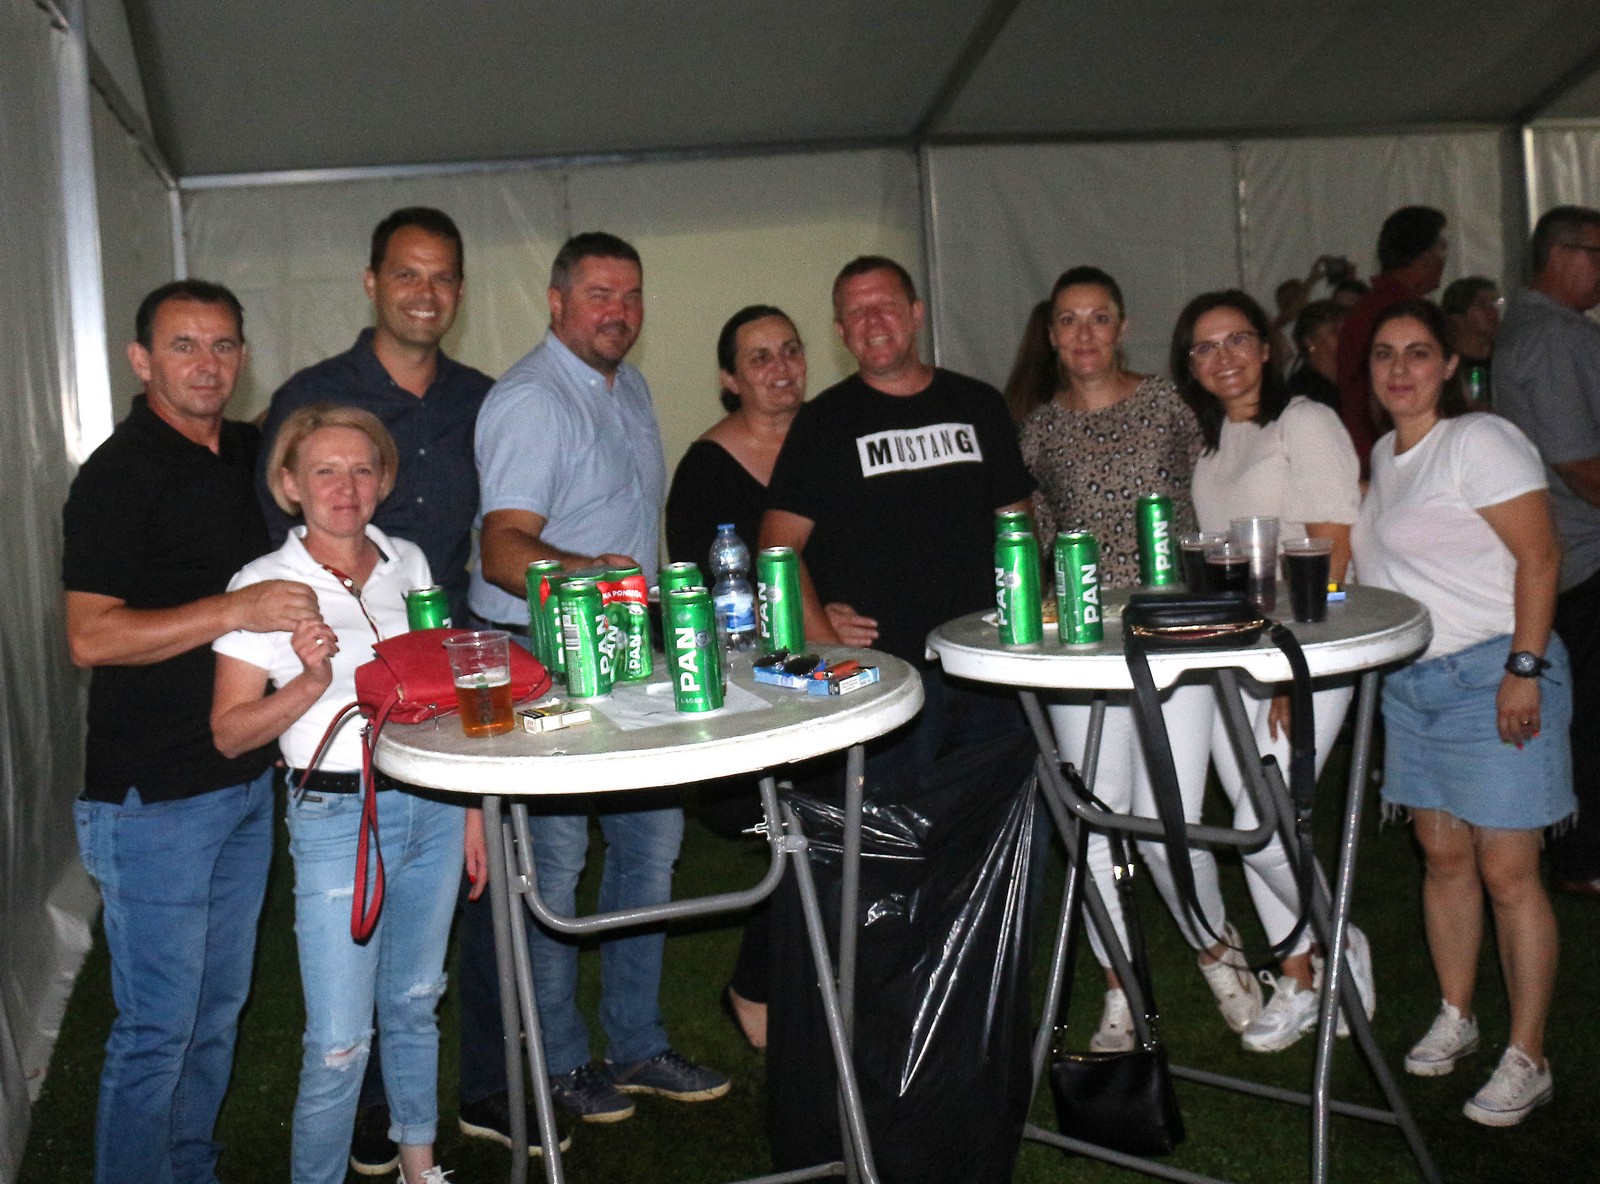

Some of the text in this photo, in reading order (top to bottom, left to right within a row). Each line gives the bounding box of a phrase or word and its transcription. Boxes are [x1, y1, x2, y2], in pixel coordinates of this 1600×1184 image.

[866, 430, 974, 467] MUSTANG
[1152, 521, 1171, 571] PAN
[758, 582, 770, 638] PAN
[995, 568, 1008, 626] PAN
[1081, 564, 1099, 624] PAN
[595, 614, 610, 675] PAN
[629, 634, 642, 669] PAN
[675, 627, 701, 692] PAN
